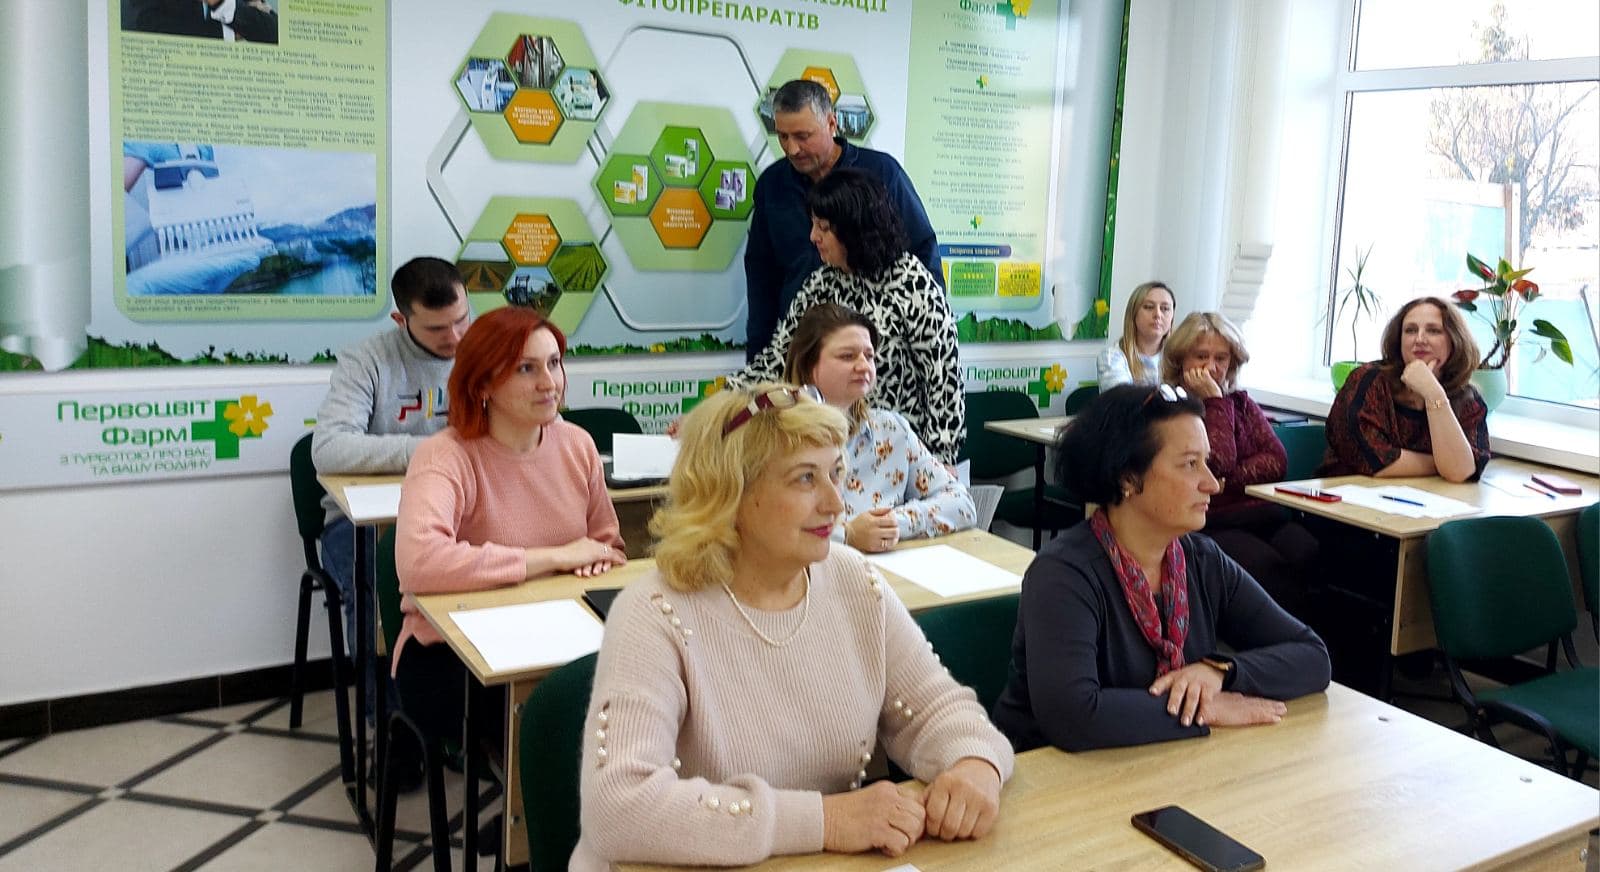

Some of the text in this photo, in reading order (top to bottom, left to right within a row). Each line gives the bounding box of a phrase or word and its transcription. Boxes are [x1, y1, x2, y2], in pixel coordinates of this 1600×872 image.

[966, 366, 1039, 382] Первоцвіт
[592, 379, 697, 400] Первоцвіт
[57, 400, 210, 423] Первоцвіт
[622, 400, 680, 419] Фарм
[102, 426, 187, 446] Фарм
[184, 446, 208, 458] ВАС
[89, 464, 110, 477] ТА
[112, 462, 152, 474] ВАШУ
